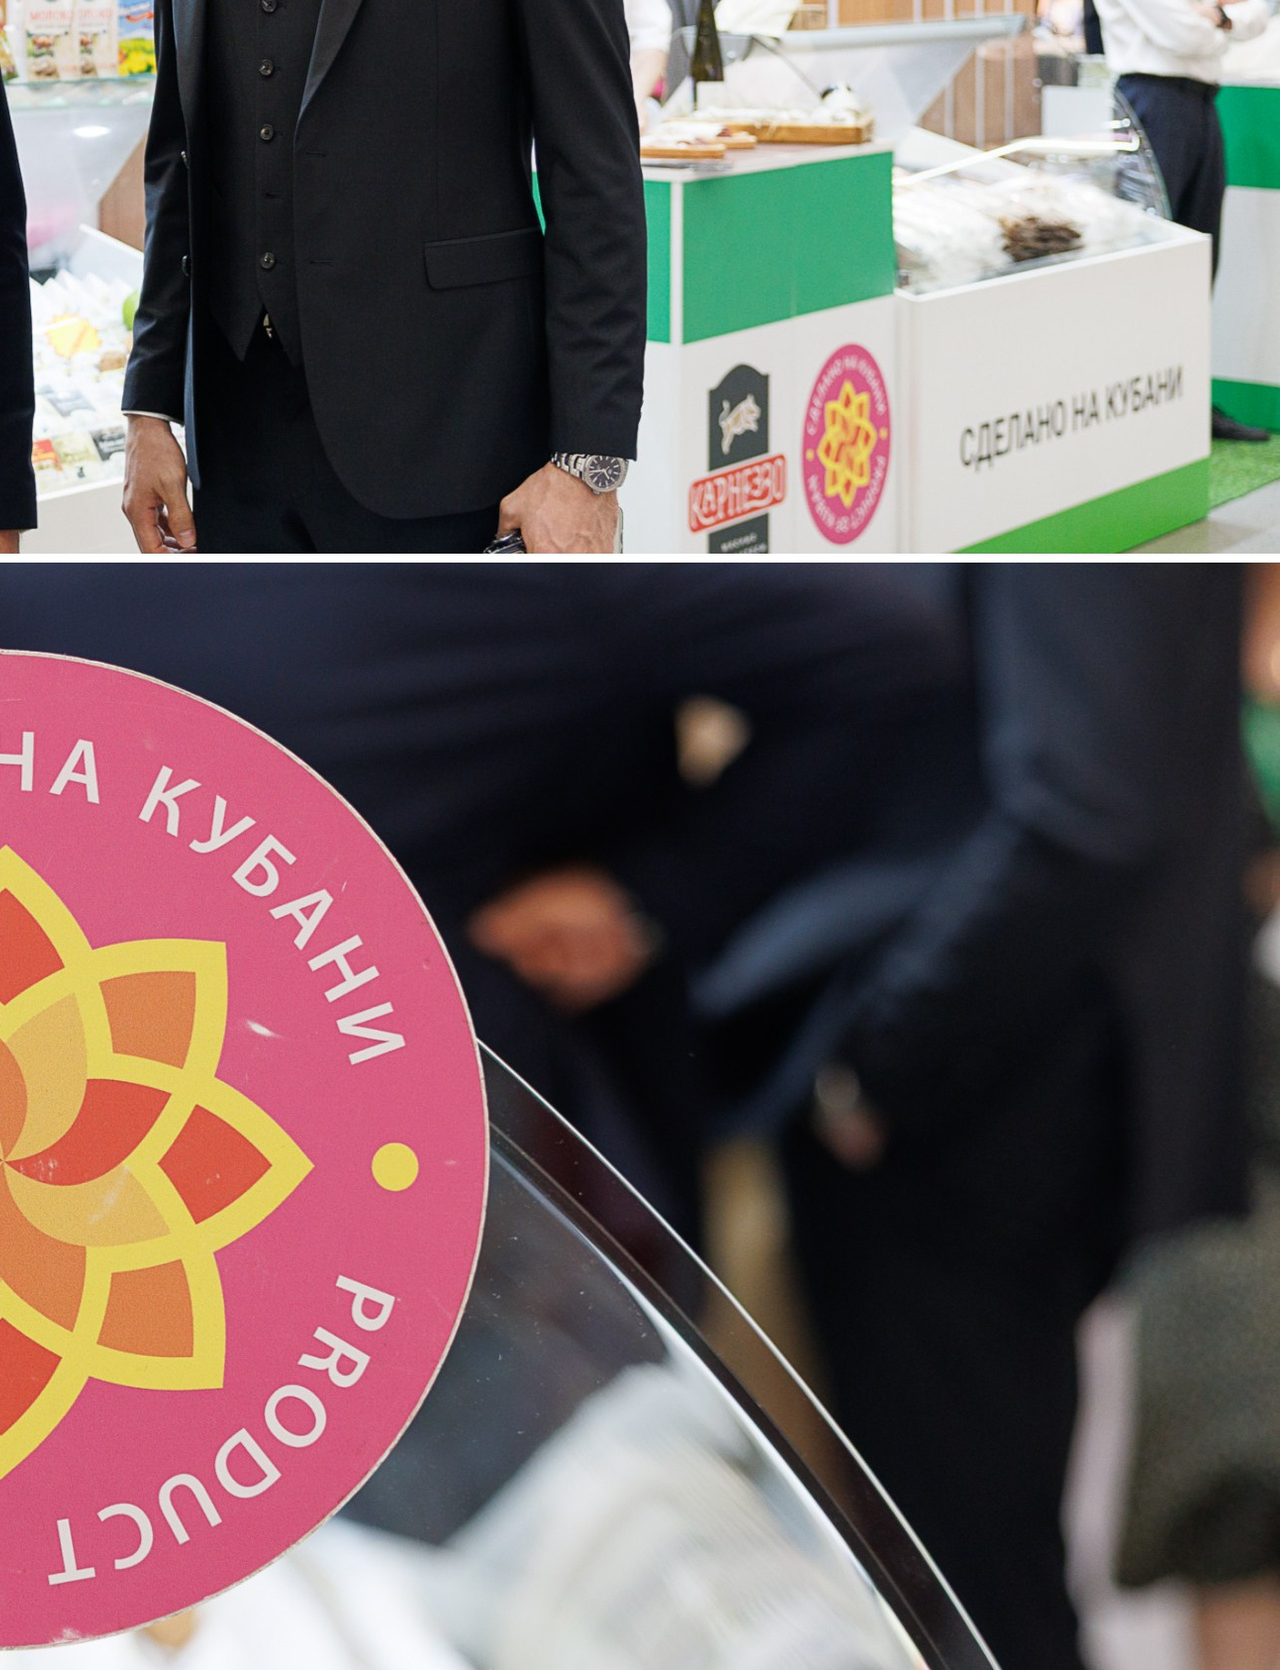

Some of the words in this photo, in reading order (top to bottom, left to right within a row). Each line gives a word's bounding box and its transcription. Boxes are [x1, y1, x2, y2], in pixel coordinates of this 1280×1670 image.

[958, 399, 1067, 472] СДЕЛАНО
[1072, 389, 1101, 431] НА
[1105, 364, 1183, 421] КУБАНИ
[138, 765, 406, 1066] КУБАНИ
[47, 1274, 396, 1586] PRODUCT
